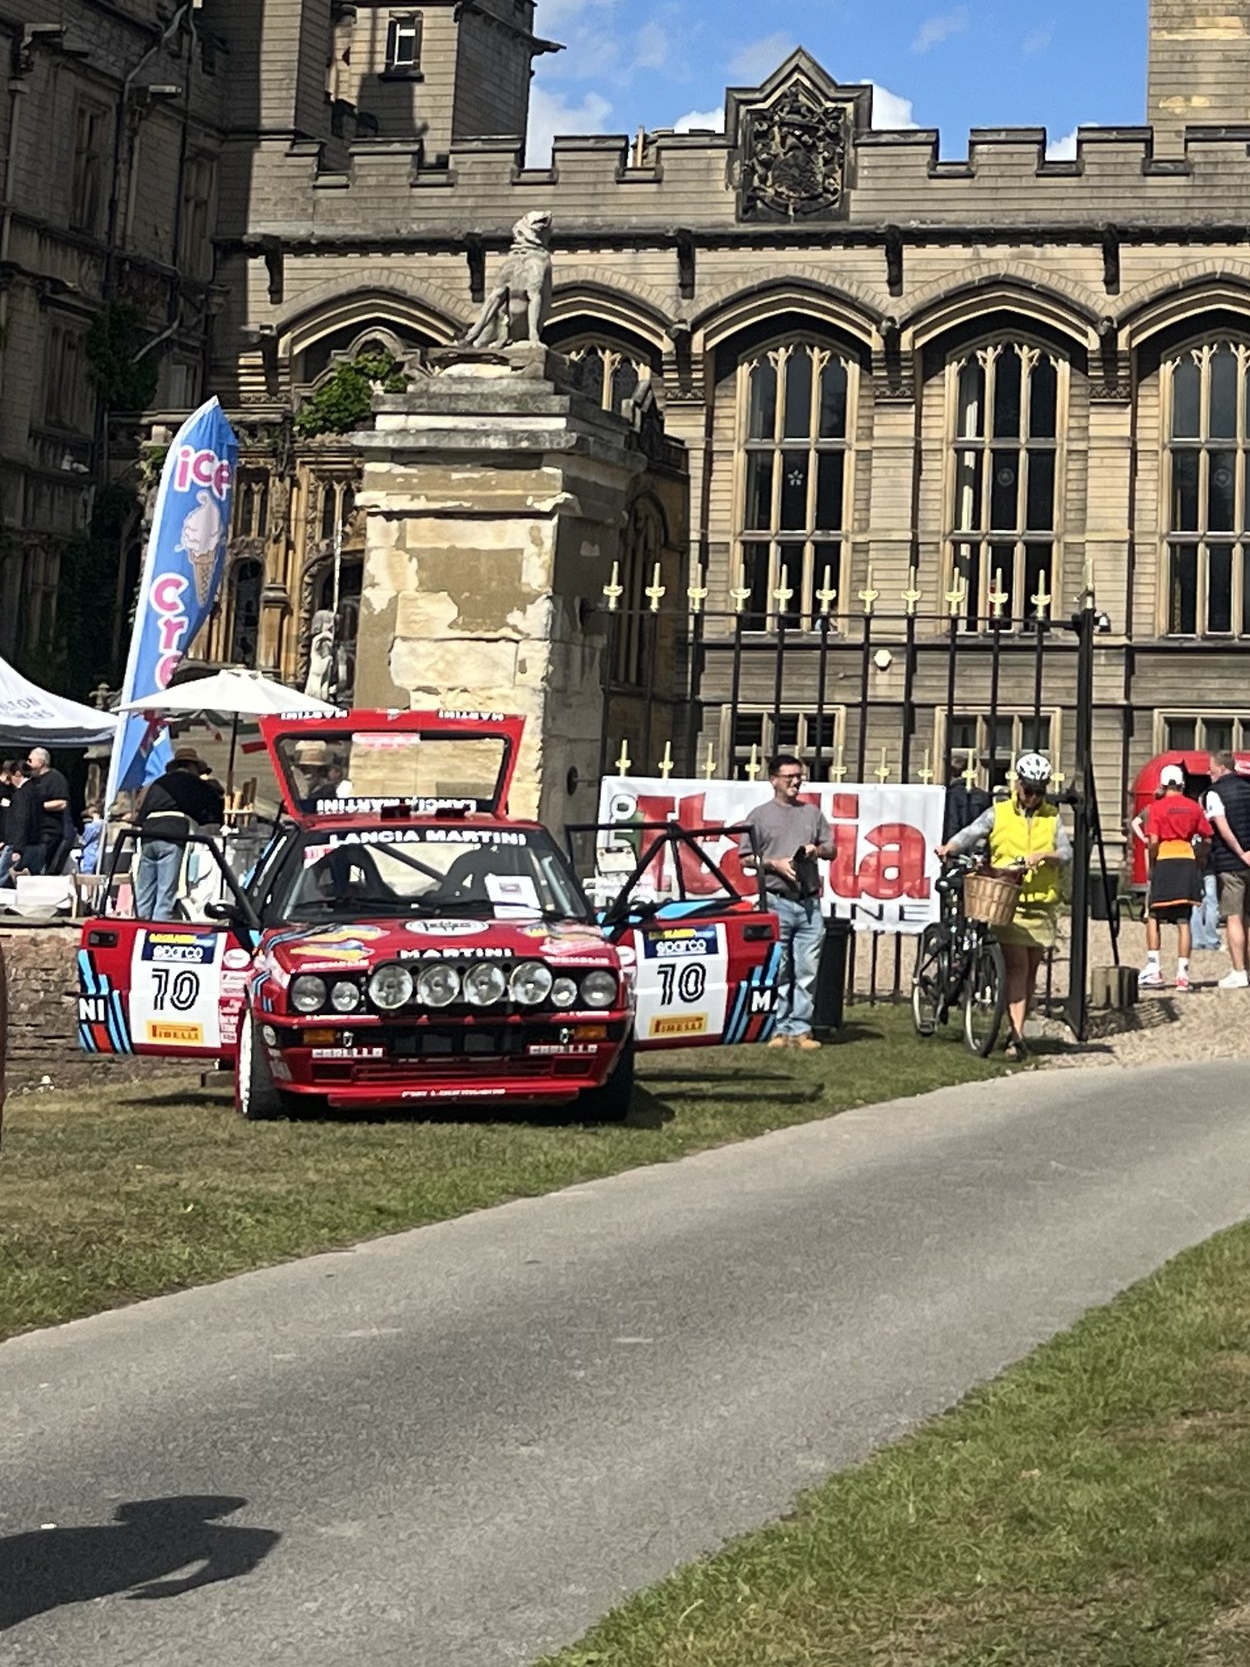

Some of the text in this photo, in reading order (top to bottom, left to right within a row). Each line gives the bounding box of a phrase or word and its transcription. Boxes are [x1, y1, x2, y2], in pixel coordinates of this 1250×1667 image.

[174, 445, 233, 501] ice
[329, 829, 527, 846] LANCIA MARTINI
[399, 948, 513, 959] MARTINI
[151, 968, 201, 1011] 10
[656, 962, 707, 1006] 10
[151, 1024, 200, 1041] PIRELLI
